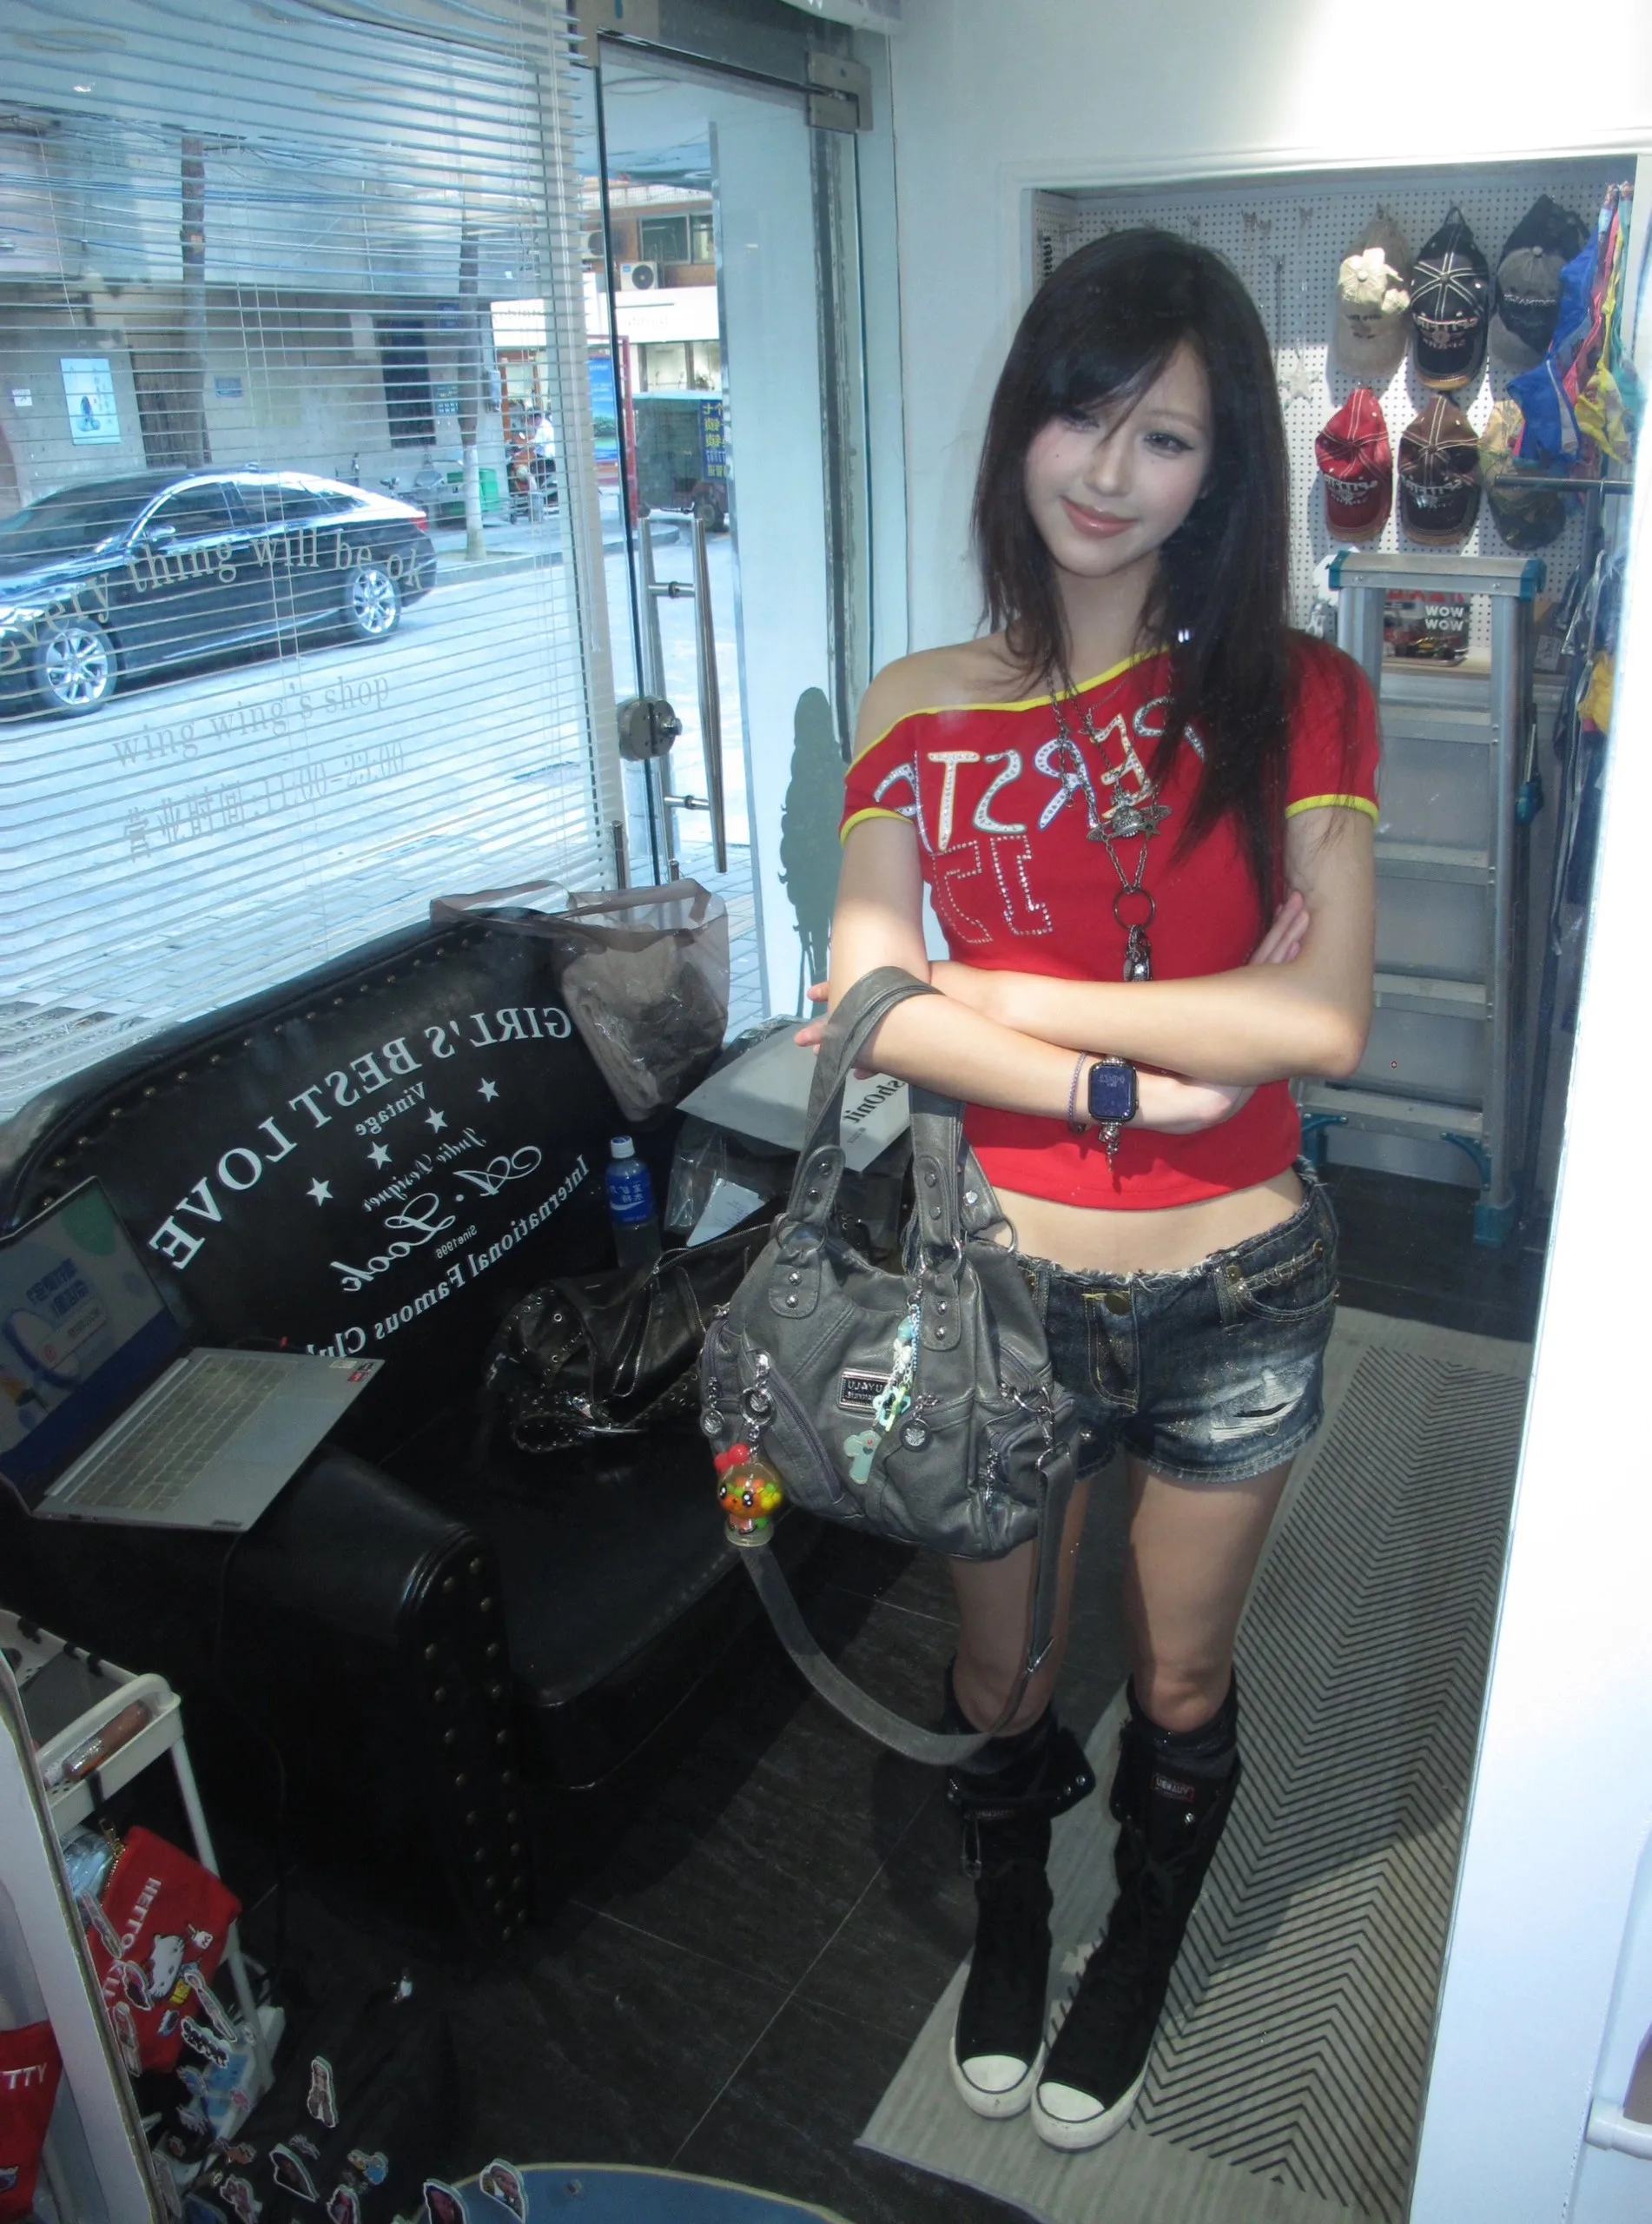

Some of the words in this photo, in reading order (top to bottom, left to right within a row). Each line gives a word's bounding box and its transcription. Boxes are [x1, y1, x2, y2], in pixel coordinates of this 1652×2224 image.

[127, 538, 236, 592] thing
[249, 527, 320, 569] will
[335, 529, 373, 571] be
[386, 549, 423, 591] ok
[112, 723, 199, 767] wing
[210, 682, 313, 740] wing's
[325, 676, 390, 713] shop
[0, 2062, 48, 2091] TTY
